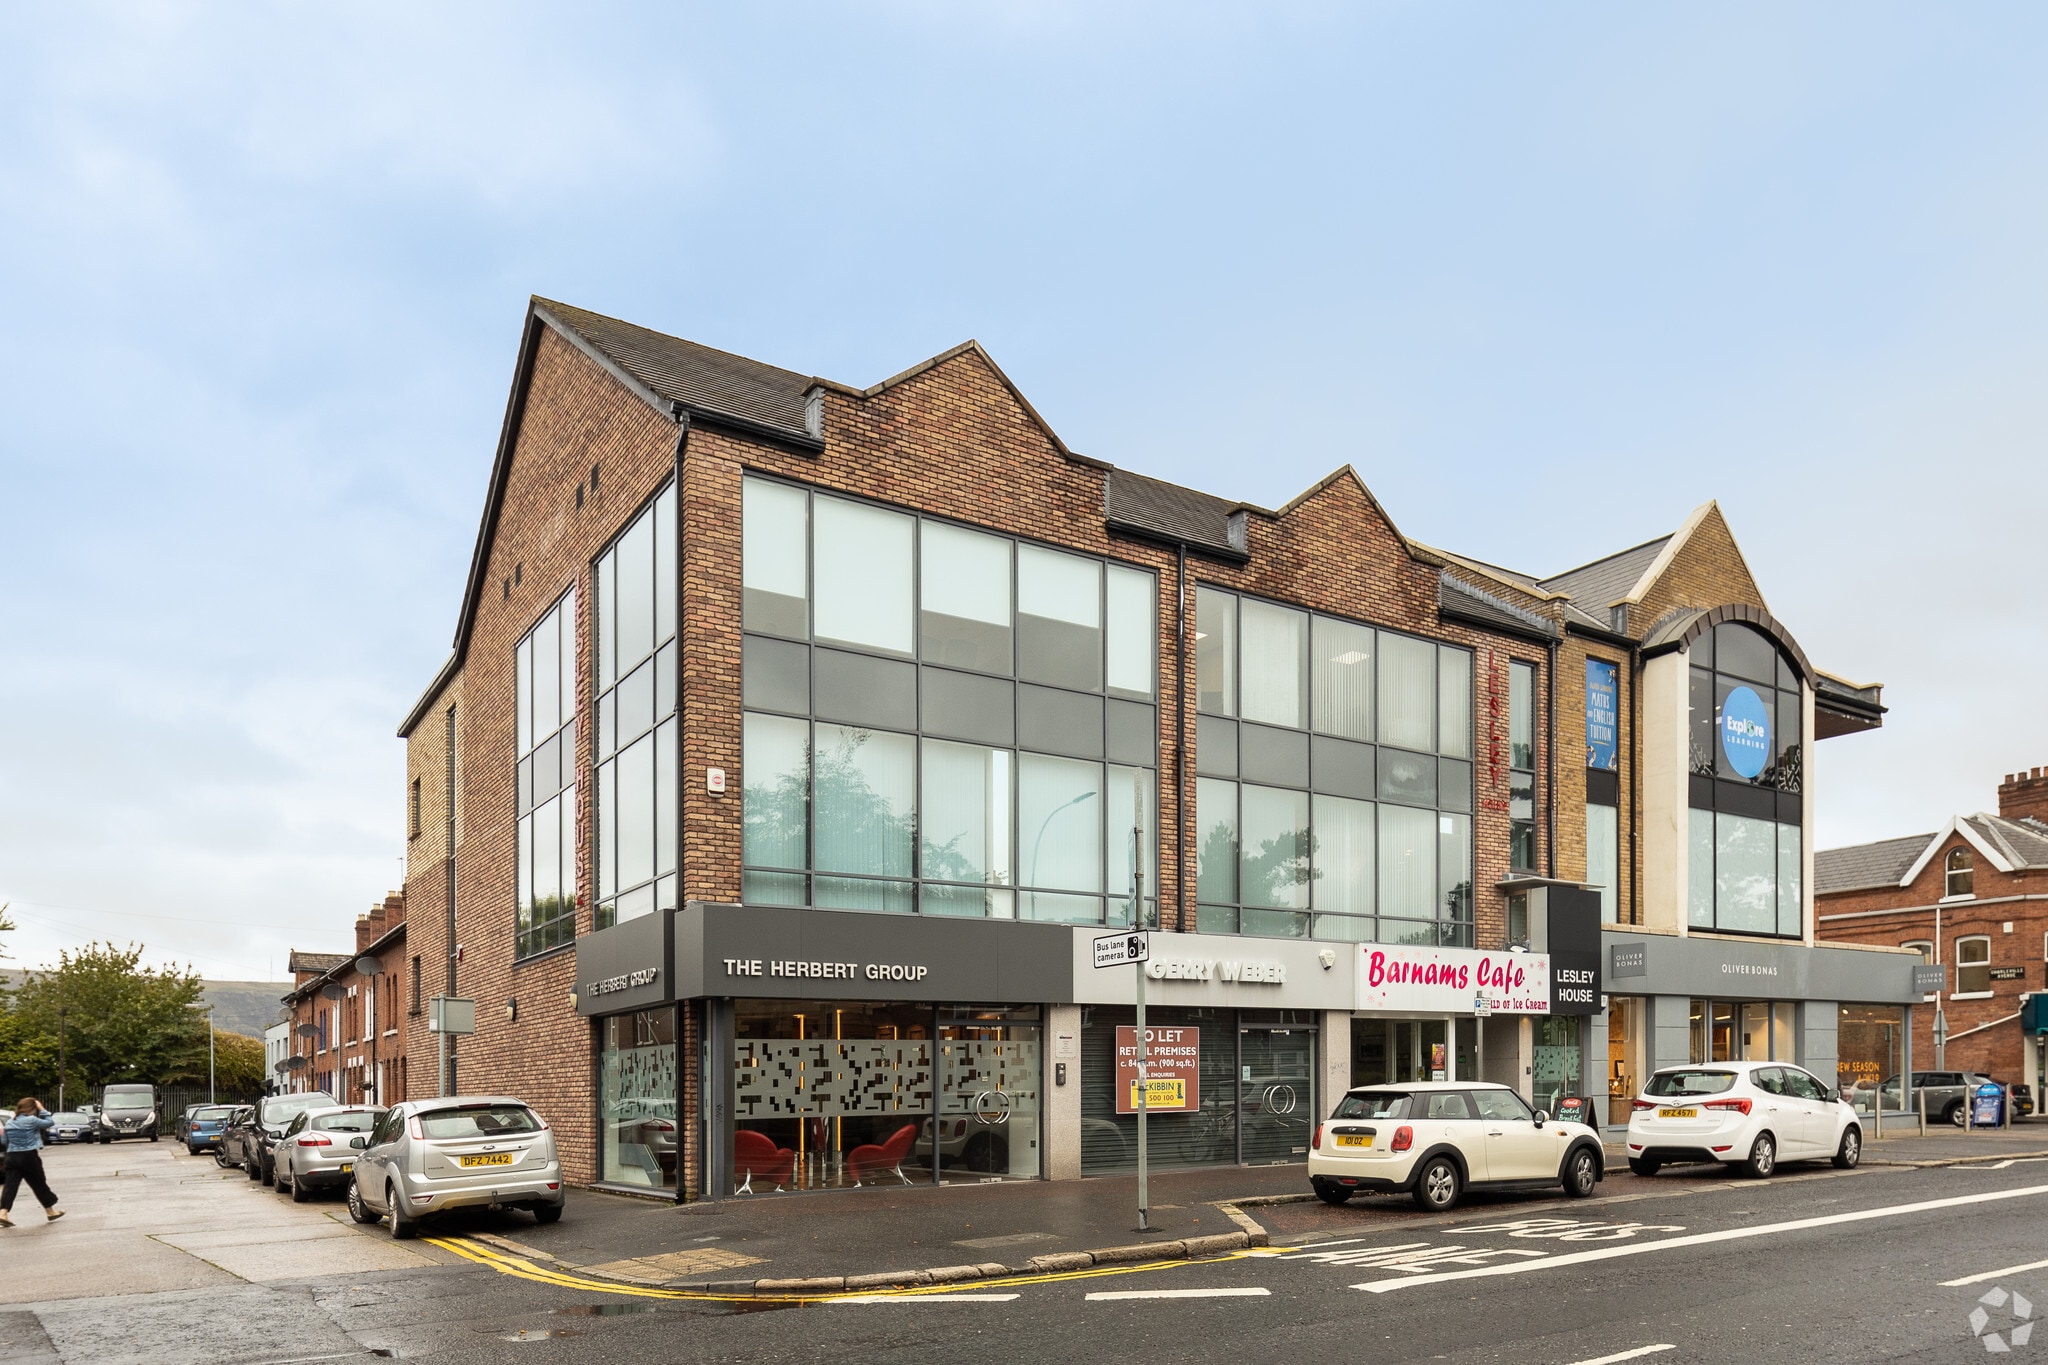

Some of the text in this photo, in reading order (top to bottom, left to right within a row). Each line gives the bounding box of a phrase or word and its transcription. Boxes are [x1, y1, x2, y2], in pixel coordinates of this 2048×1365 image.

[1489, 650, 1501, 787] LESLEY
[1727, 715, 1765, 738] Explore
[575, 573, 585, 906] LESLEY HOUSE
[1727, 735, 1765, 750] LEARNING
[1096, 940, 1125, 952] Bus lane
[1097, 951, 1125, 962] cameras
[1615, 953, 1643, 961] OLIVER
[723, 959, 928, 981] THE HERBERT GROUP
[1148, 957, 1288, 983] GERRY WEBER
[1616, 960, 1643, 968] BONAS
[1721, 963, 1778, 976] OLIVER BONAS
[1368, 951, 1525, 995] Barnams Cafe
[1557, 969, 1594, 984] LESLEY
[586, 967, 657, 997] THE HERBERT GROUP
[1559, 988, 1593, 1003] HOUSE
[1513, 998, 1523, 1009] Ice
[1158, 1030, 1184, 1042] LET
[1119, 1047, 1197, 1056] RETL PREMISES
[1159, 1059, 1174, 1069] (900
[1175, 1059, 1195, 1069] sq.ft.)
[1852, 1061, 1880, 1072] SEASON
[1146, 1082, 1174, 1091] cKIBBIN
[1662, 1109, 1693, 1117] RFZ 4571
[464, 1155, 509, 1166] DFZ 7442
[1440, 1218, 1687, 1241] BUS
